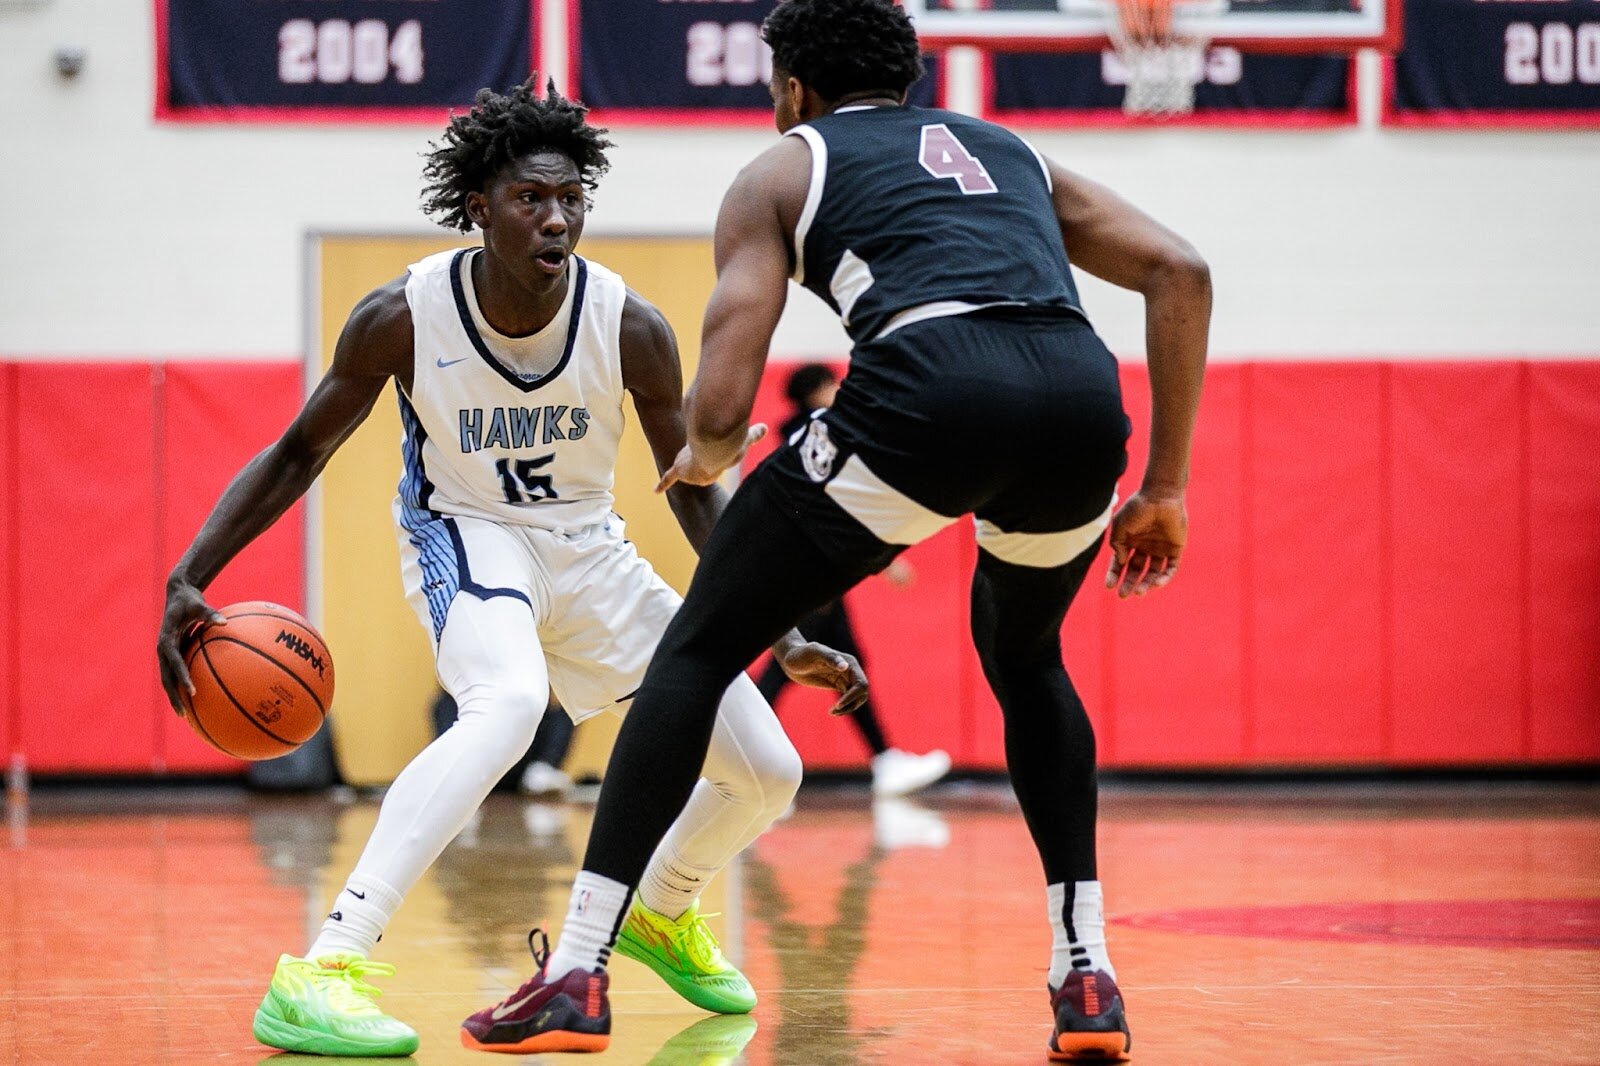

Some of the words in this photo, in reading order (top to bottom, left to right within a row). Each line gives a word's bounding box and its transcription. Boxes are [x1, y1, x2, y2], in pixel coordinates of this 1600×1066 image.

[277, 18, 424, 83] 2004
[918, 123, 999, 195] 4
[459, 405, 590, 453] HAWKS
[495, 452, 559, 504] 15
